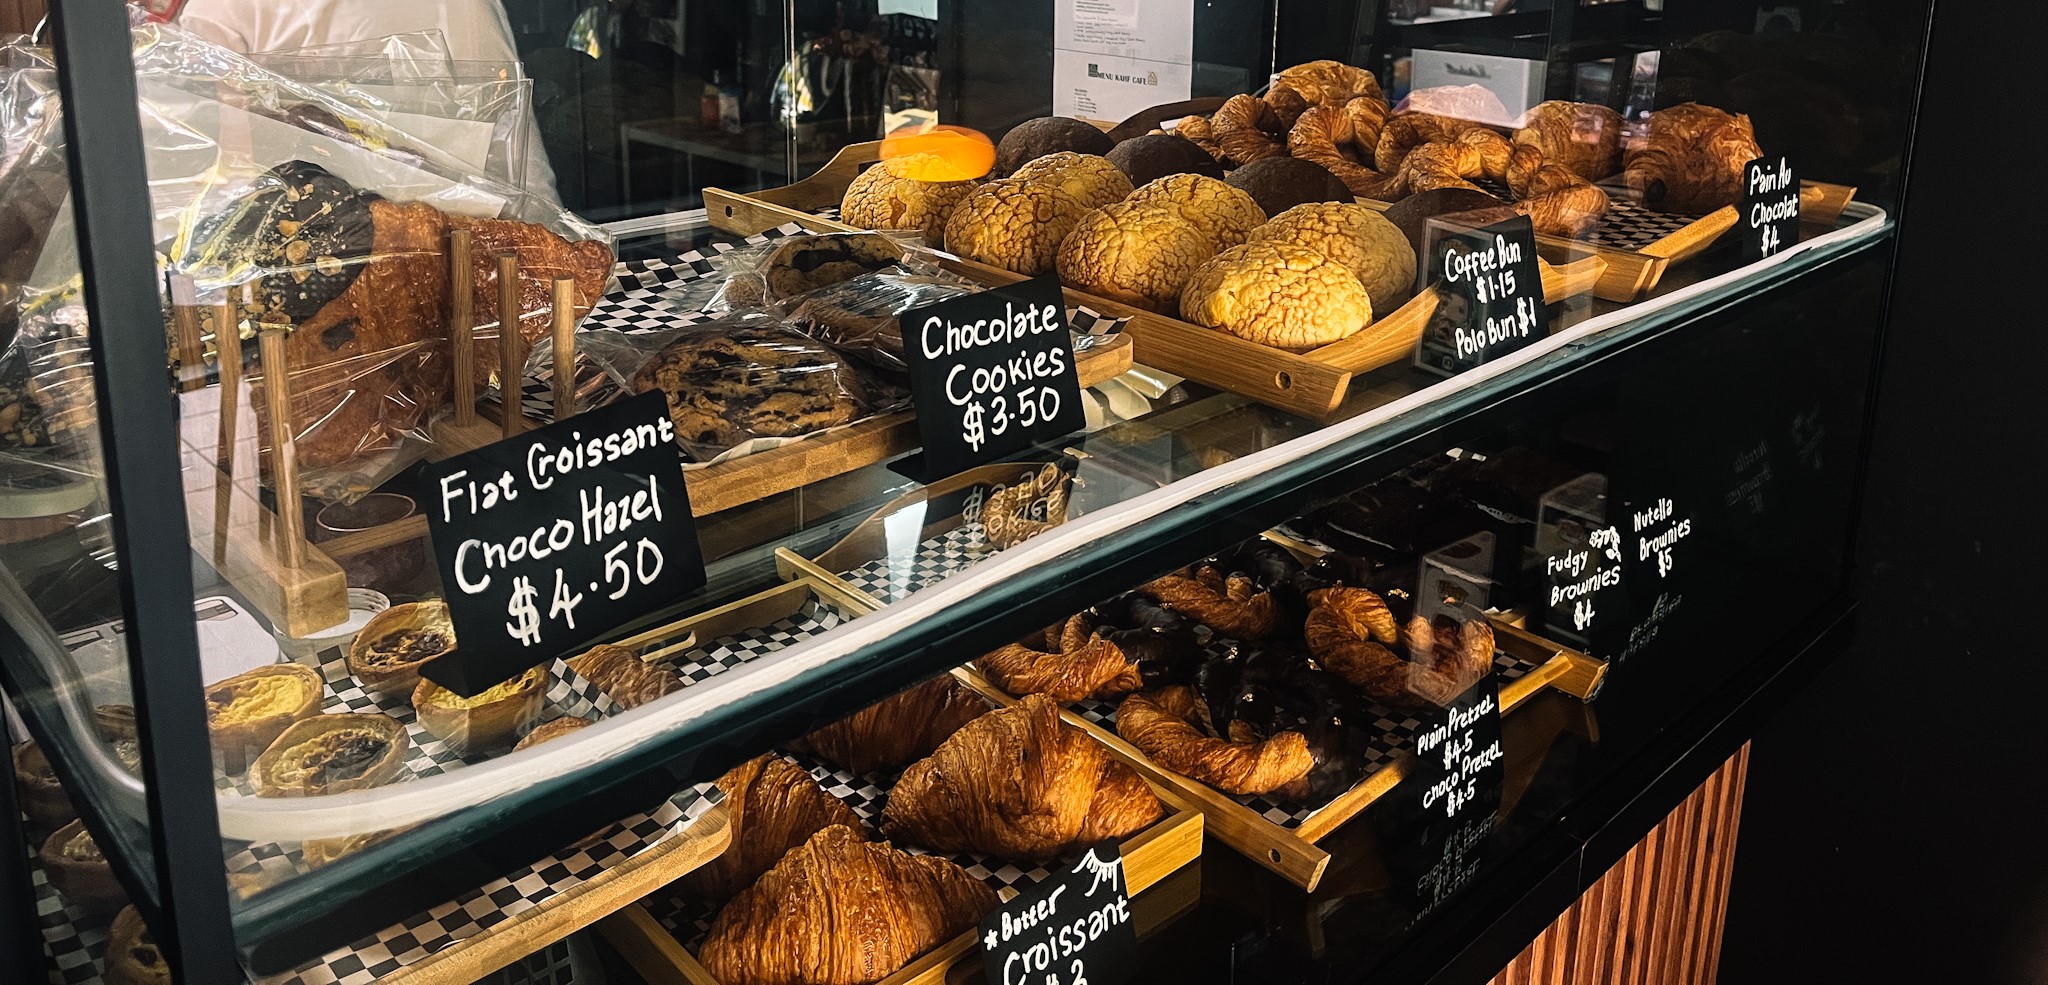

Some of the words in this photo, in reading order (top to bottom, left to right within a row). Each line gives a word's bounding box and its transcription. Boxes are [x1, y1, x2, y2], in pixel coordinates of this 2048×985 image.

[1132, 77, 1147, 86] CAFE
[1750, 165, 1776, 196] Pain
[1777, 156, 1792, 190] Au
[1751, 193, 1799, 229] Chocolat
[1445, 247, 1497, 283] Coffee
[1496, 234, 1521, 269] Bun
[1761, 223, 1780, 258] $4
[921, 301, 1059, 360] Chocolate
[1455, 327, 1486, 360] Polo
[1486, 314, 1517, 346] Bun
[1517, 296, 1536, 338] $1
[945, 347, 1066, 406] Cookies
[962, 386, 1060, 452] $3.50
[440, 470, 519, 523] Flat
[526, 416, 674, 491] Croissant
[579, 474, 663, 546] Hazel
[1633, 498, 1673, 532] Nutella
[1640, 519, 1691, 561] Brownies
[1547, 549, 1589, 577] Fudgy
[1658, 547, 1673, 578] $5
[506, 537, 664, 647] $4.50
[1550, 565, 1621, 607] Brownies
[1573, 598, 1596, 631] $4
[1417, 723, 1447, 756] Plain
[1443, 728, 1474, 770] $4.5
[1446, 777, 1477, 818] $4.5
[1001, 884, 1067, 942] Butter
[1003, 894, 1130, 985] Croissant
